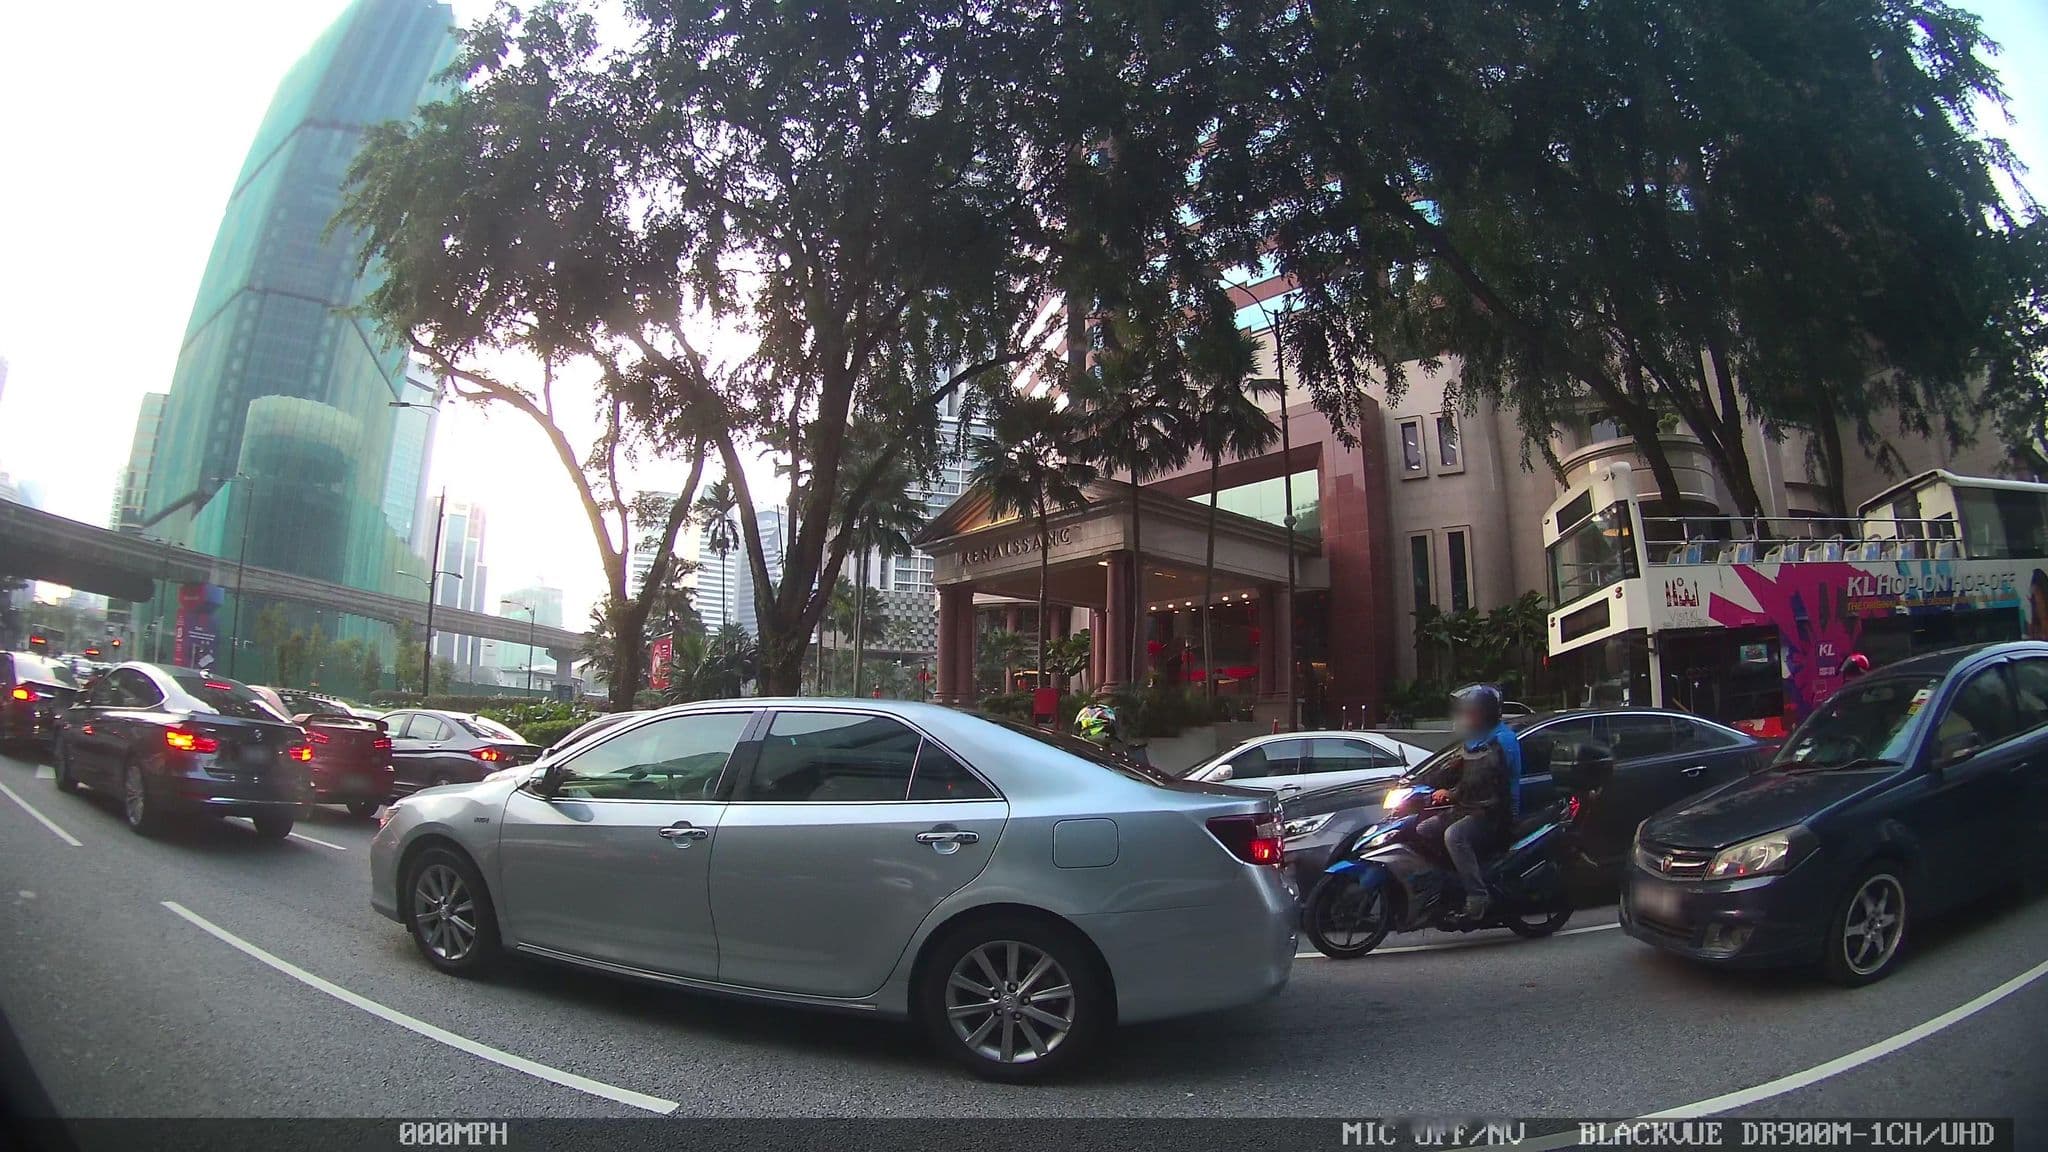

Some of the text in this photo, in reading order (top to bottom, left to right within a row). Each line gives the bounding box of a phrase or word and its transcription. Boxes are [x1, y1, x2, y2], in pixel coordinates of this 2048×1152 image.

[959, 525, 1082, 566] RENAISSANC
[1847, 575, 1875, 597] KL
[1879, 572, 1948, 596] HOP-ON
[1819, 644, 1836, 656] KL
